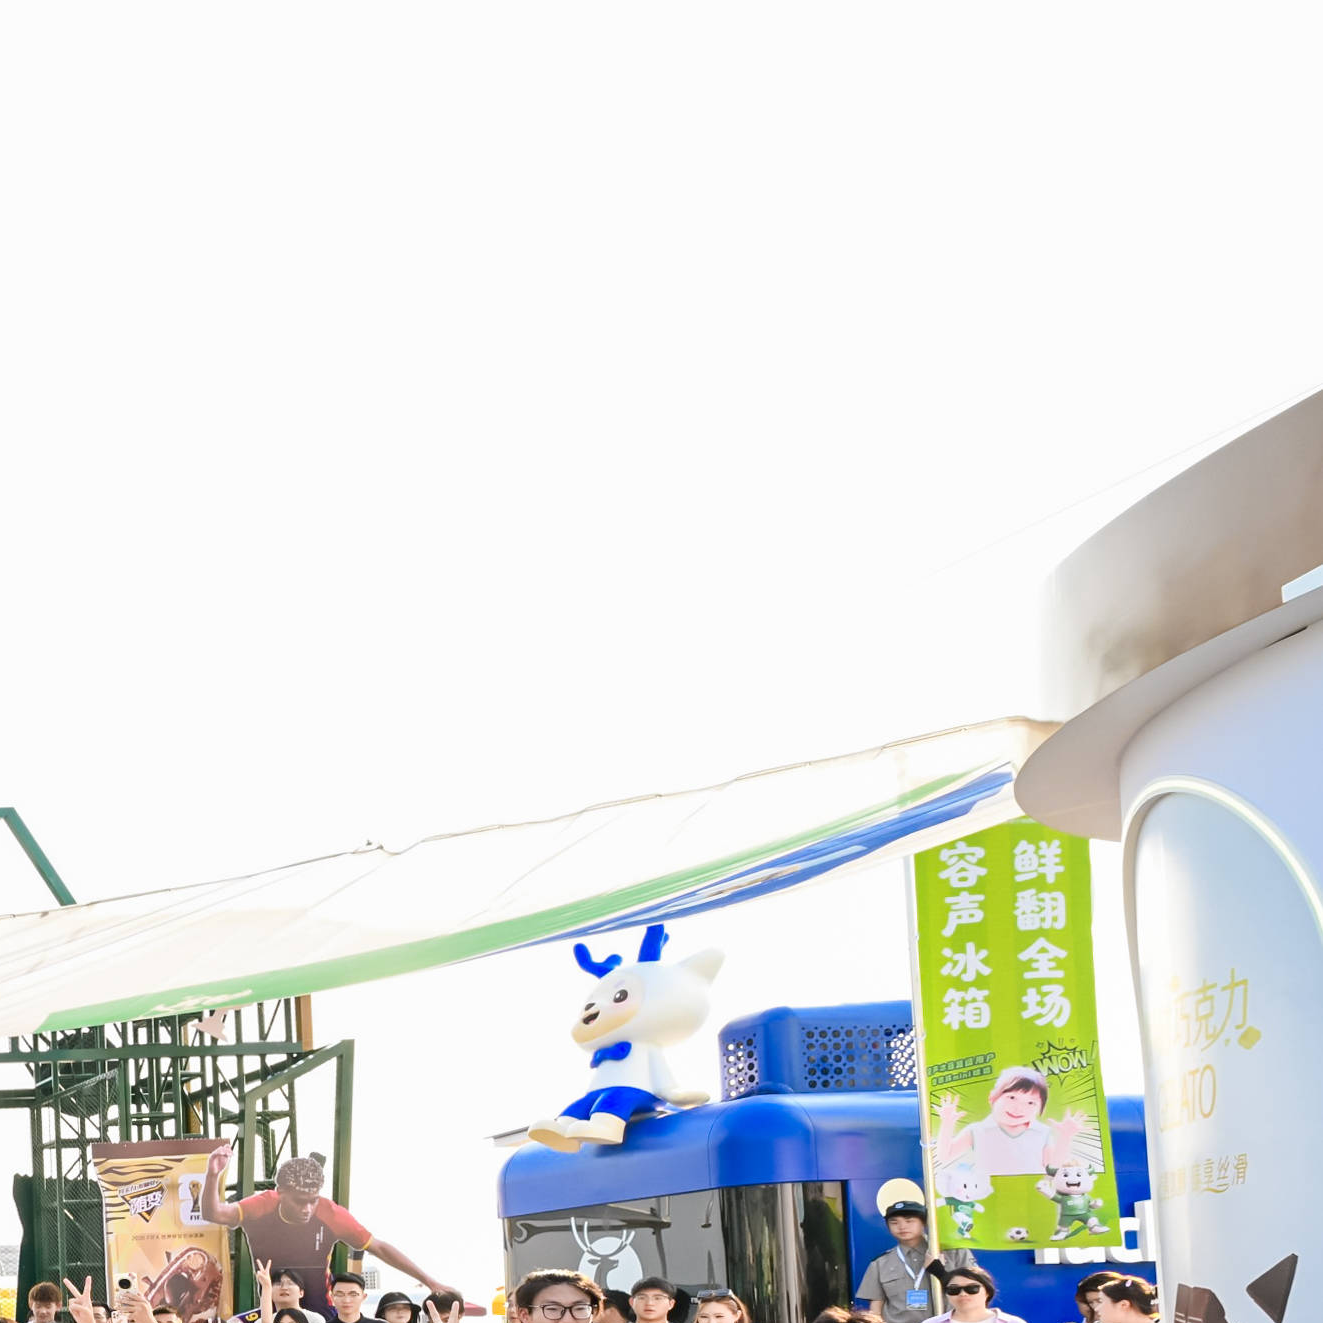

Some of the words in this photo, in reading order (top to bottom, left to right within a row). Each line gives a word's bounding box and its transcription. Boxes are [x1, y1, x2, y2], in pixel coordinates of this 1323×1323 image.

[938, 840, 993, 1031] 容声冰箱
[1013, 838, 1072, 1028] 鲜翻全场
